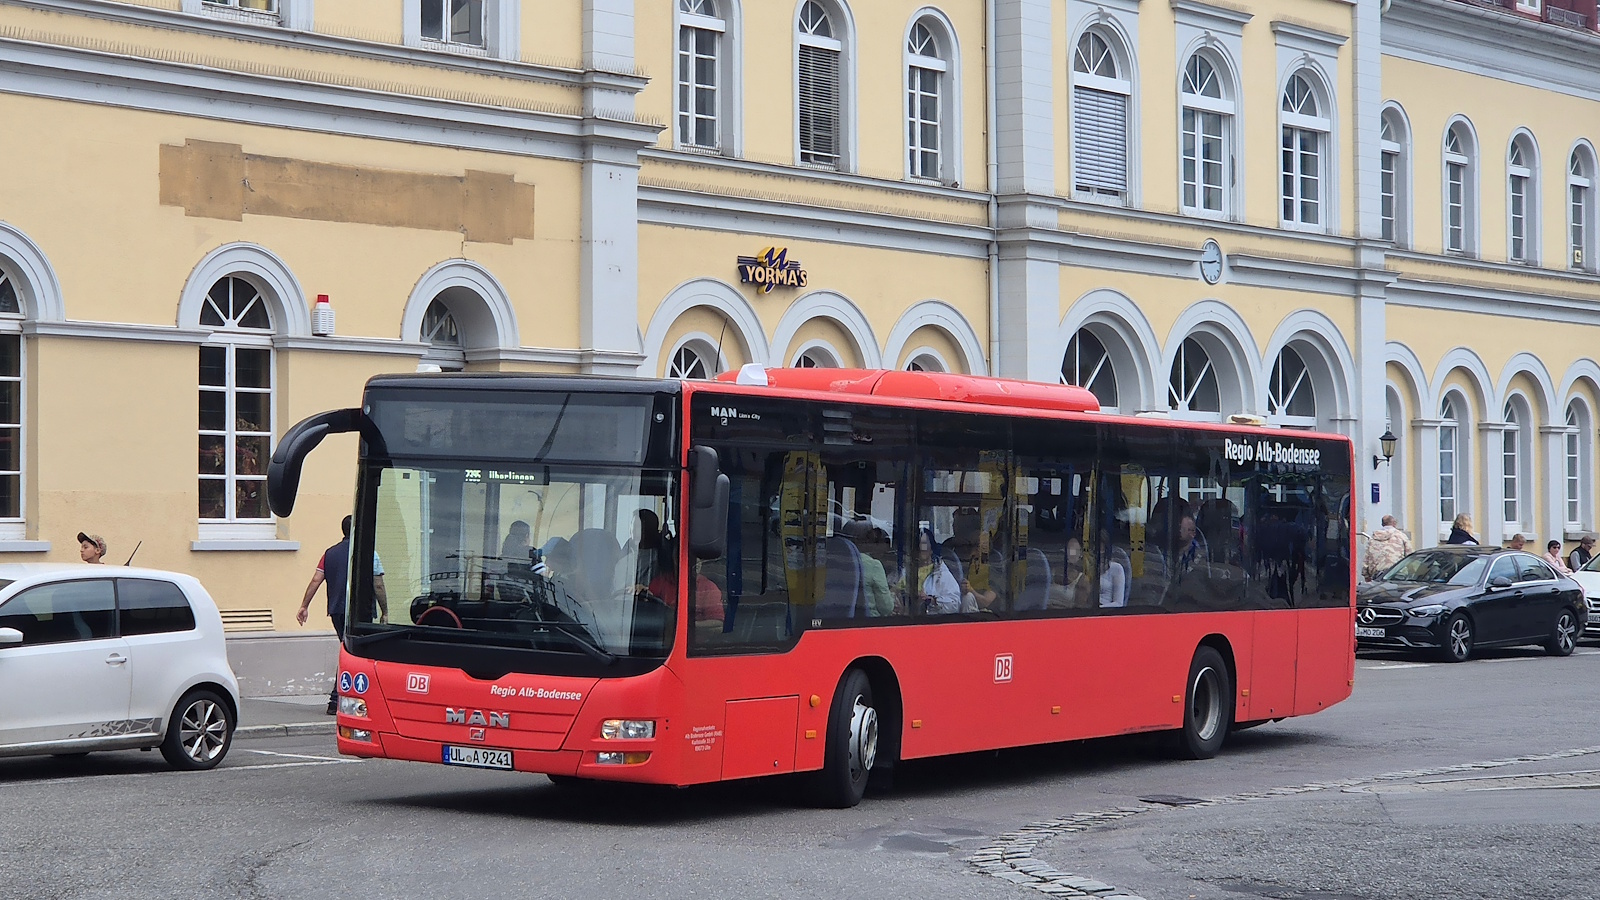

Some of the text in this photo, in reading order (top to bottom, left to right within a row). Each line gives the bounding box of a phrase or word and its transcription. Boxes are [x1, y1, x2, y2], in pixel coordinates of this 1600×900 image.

[746, 265, 807, 288] YORMA'S
[710, 406, 737, 418] MAN
[1224, 438, 1320, 466] Regio Alb-Bodensee
[996, 658, 1011, 678] DB
[408, 675, 428, 691] DB
[490, 684, 582, 701] Regio Alb-Bodensee
[445, 707, 511, 728] MAN
[482, 751, 512, 766] 9241
